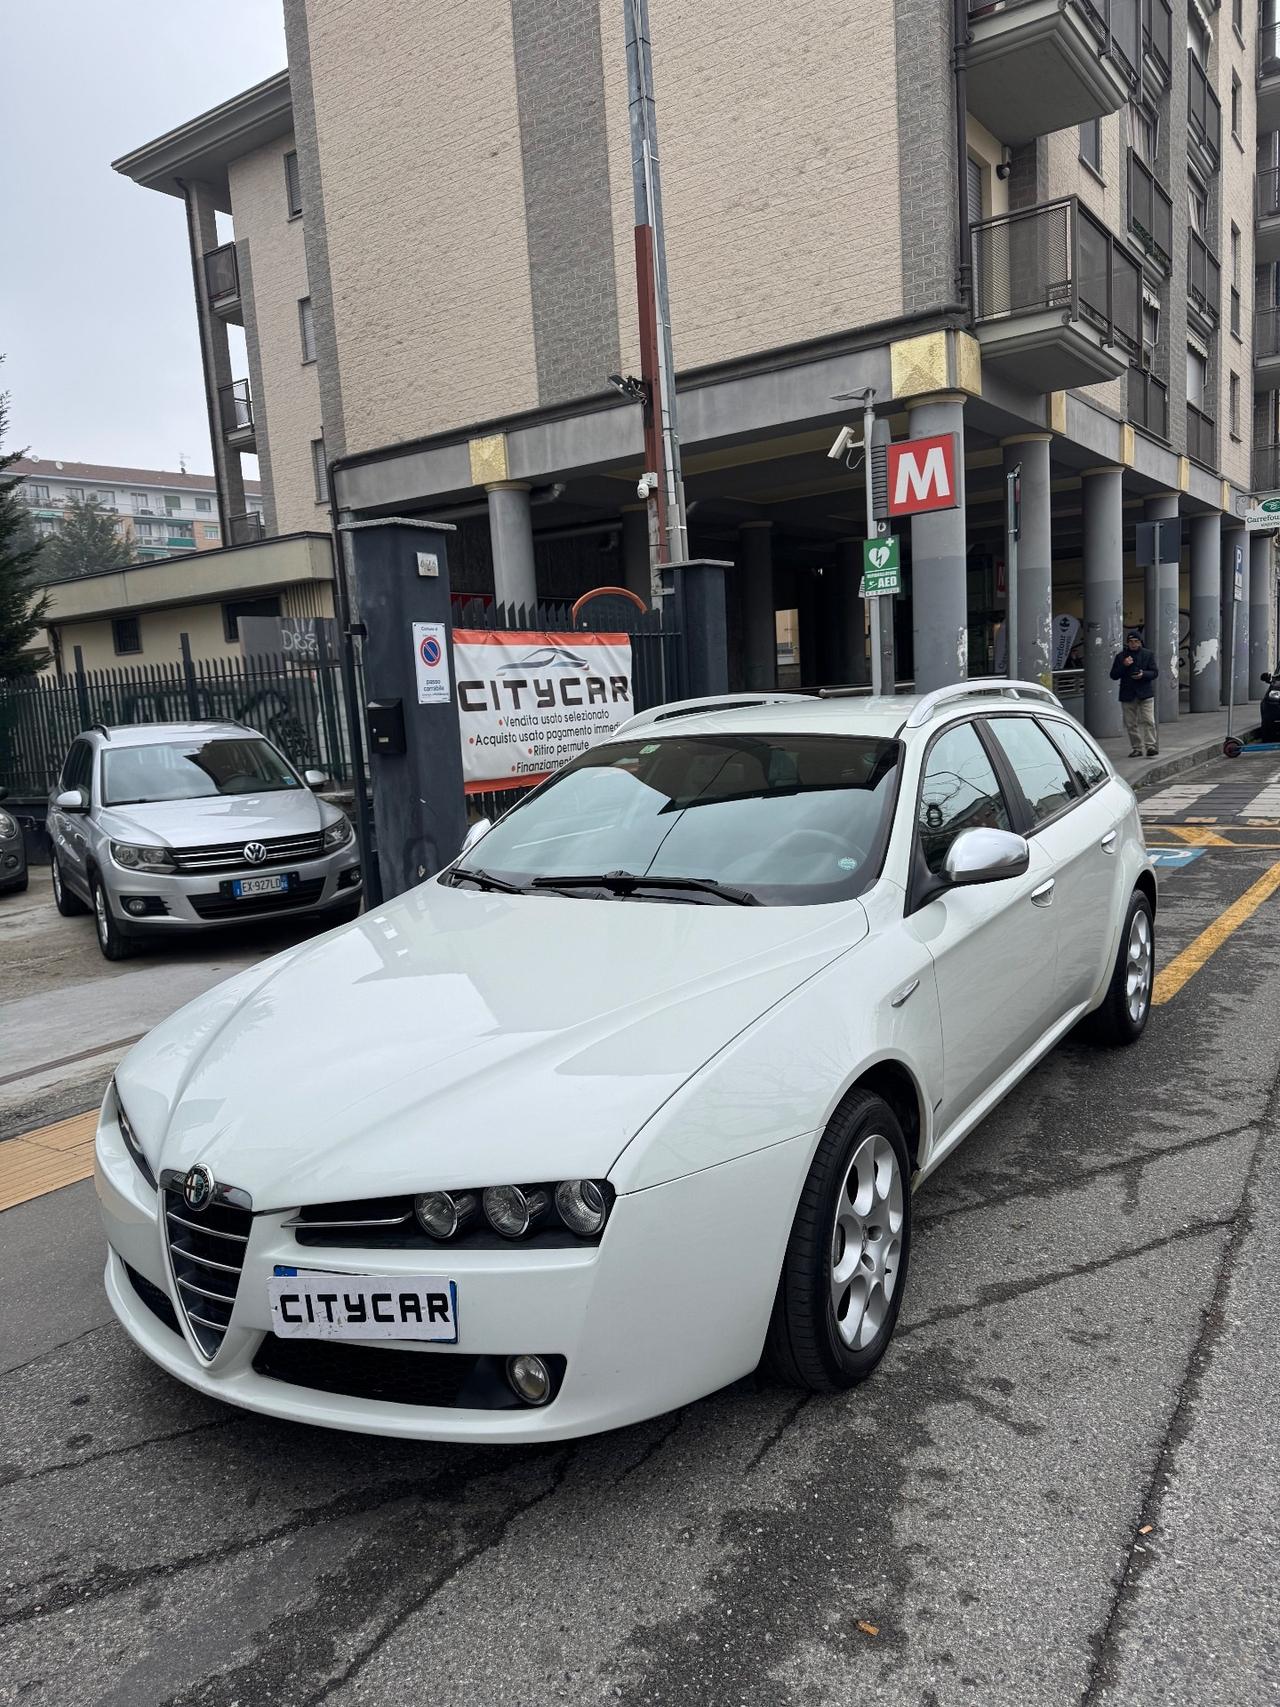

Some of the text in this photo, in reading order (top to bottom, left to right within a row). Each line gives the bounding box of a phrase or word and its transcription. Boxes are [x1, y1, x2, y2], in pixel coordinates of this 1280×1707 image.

[893, 446, 950, 504] M
[1246, 514, 1280, 524] Carrefou
[877, 576, 897, 588] AED
[457, 675, 631, 712] CITYCAR
[503, 709, 610, 727] Vendita usato selezionato
[475, 731, 518, 746] Acquisto
[518, 729, 545, 742] usato
[546, 725, 592, 743] pagamento
[533, 740, 590, 756] Ritiro permute
[279, 1292, 451, 1323] CITYCAR
